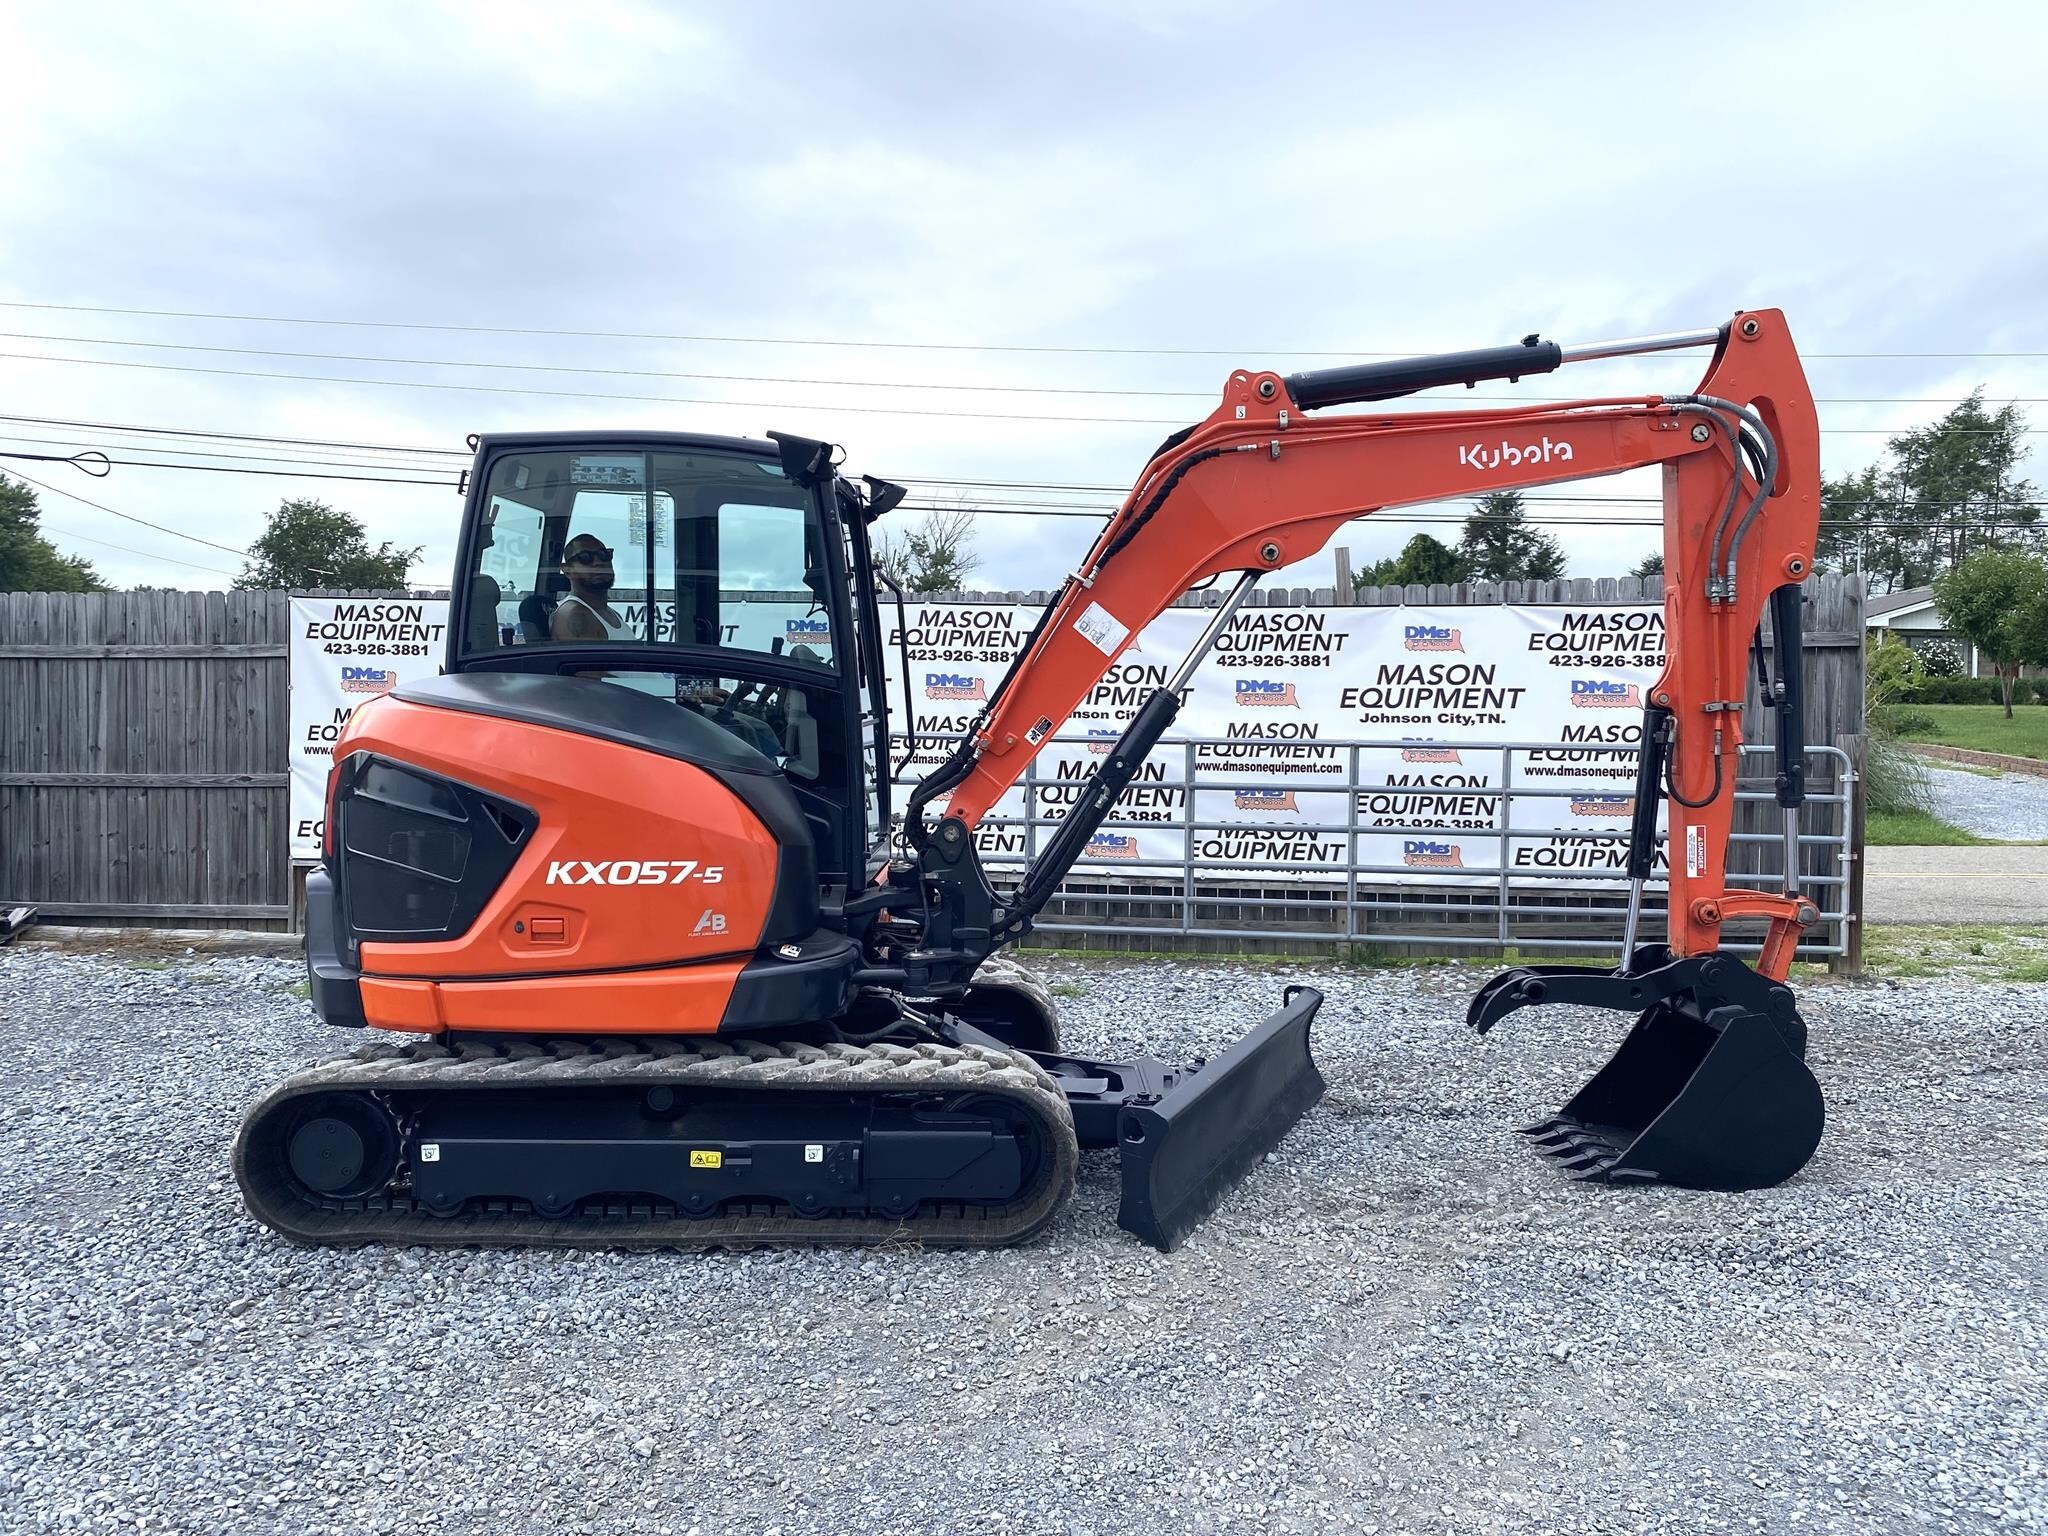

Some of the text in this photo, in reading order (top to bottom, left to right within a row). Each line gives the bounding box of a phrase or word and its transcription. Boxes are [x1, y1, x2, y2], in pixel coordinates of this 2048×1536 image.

[1459, 436, 1573, 470] Kubota
[333, 604, 423, 623] MASON
[625, 605, 676, 623] MAS
[918, 609, 1013, 629] MASON
[1228, 613, 1325, 632] MASON
[305, 622, 446, 642] EQUIPMENT
[323, 643, 429, 656] 423-926-3881
[1213, 633, 1349, 652] QUIPMENT
[1528, 633, 1665, 652] EQUIPME
[1216, 654, 1331, 667] 423-926-3881
[1549, 654, 1666, 667] 423-926-388
[1099, 664, 1168, 685] SON
[1376, 664, 1496, 686] MASON
[1340, 687, 1526, 709] EQUIPMENT
[1069, 709, 1110, 720] nson
[1359, 712, 1506, 726] Johnson City,TN.
[1226, 722, 1319, 740] MASON
[1561, 724, 1643, 743] MASO
[1529, 750, 1640, 763] EQUIPM
[1195, 760, 1343, 776] www.dmasonequipment.com
[1358, 795, 1514, 817] EQUIPMEN
[545, 861, 724, 886] KX057-5
